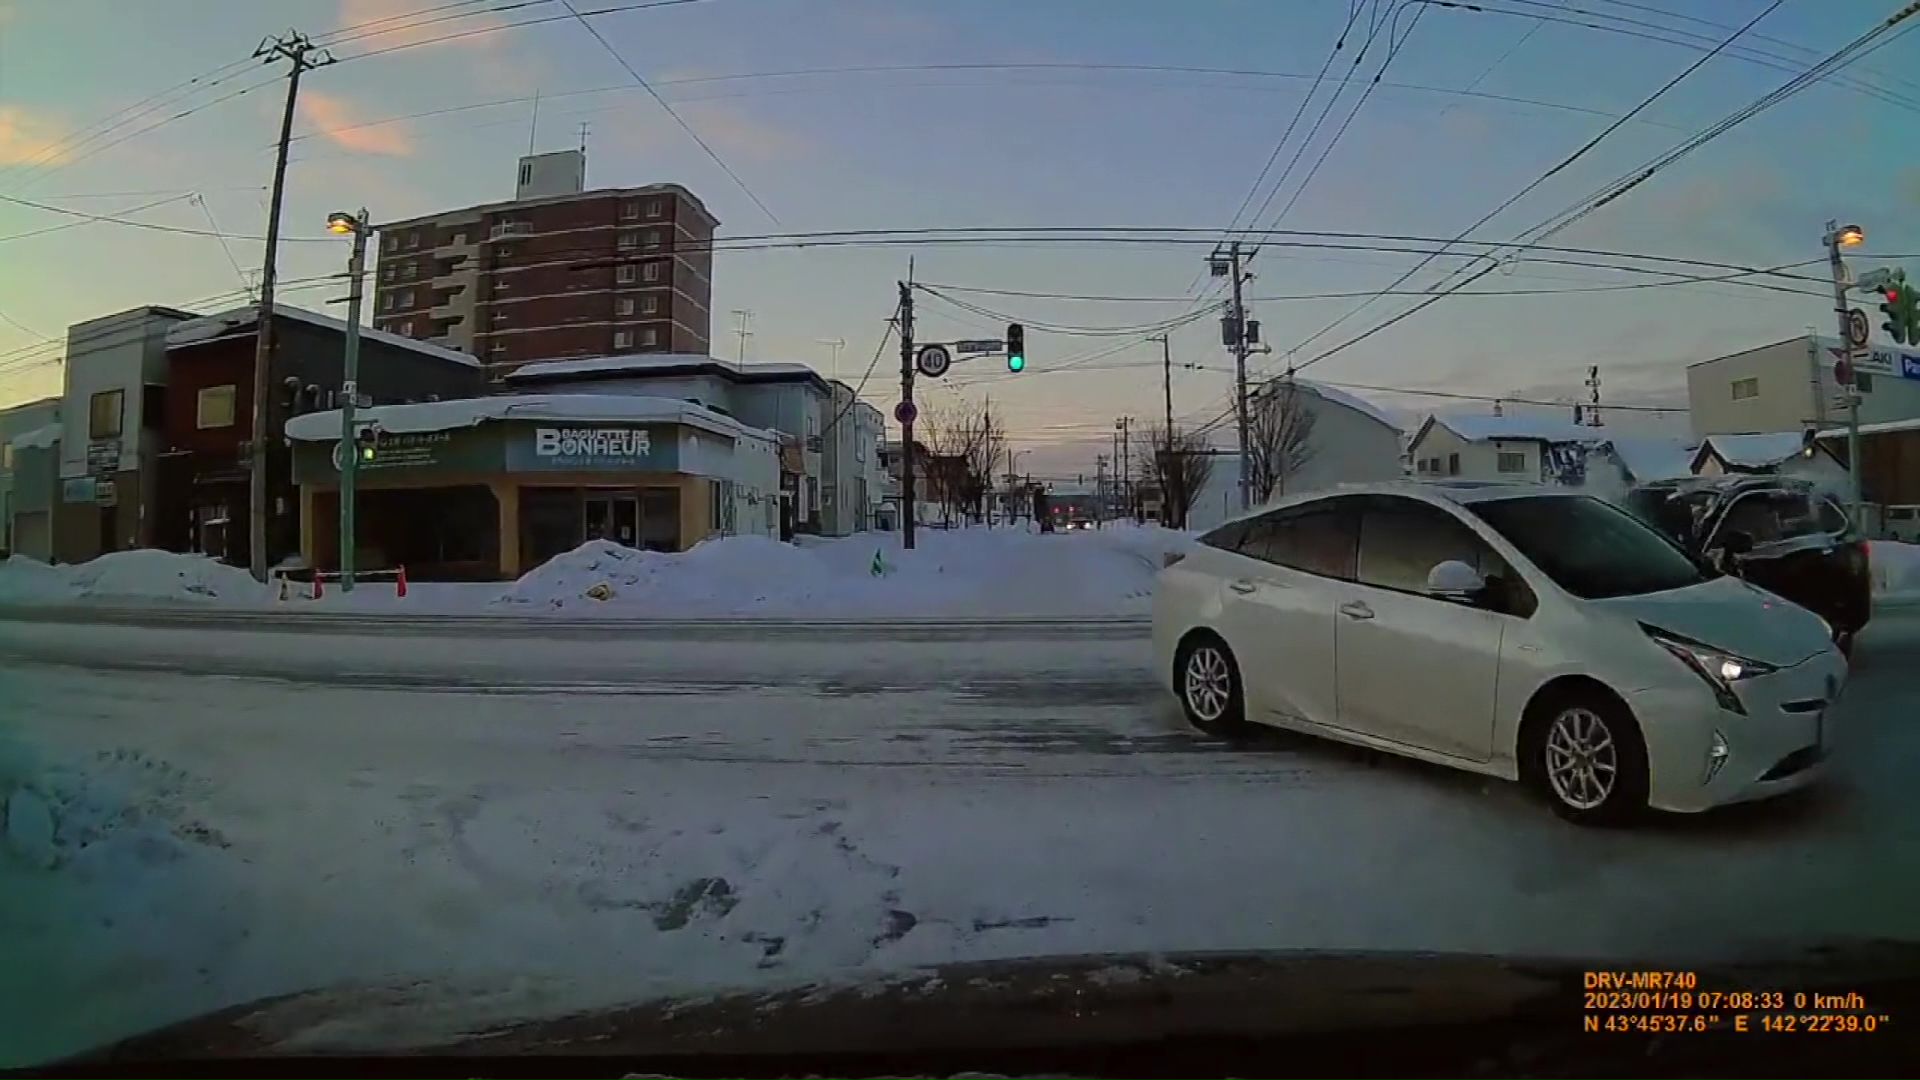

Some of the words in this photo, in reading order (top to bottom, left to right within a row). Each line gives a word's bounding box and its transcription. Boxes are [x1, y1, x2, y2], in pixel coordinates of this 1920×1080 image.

[924, 353, 943, 368] 40
[562, 429, 630, 440] BAGUETTE
[536, 429, 650, 456] BONHEUR
